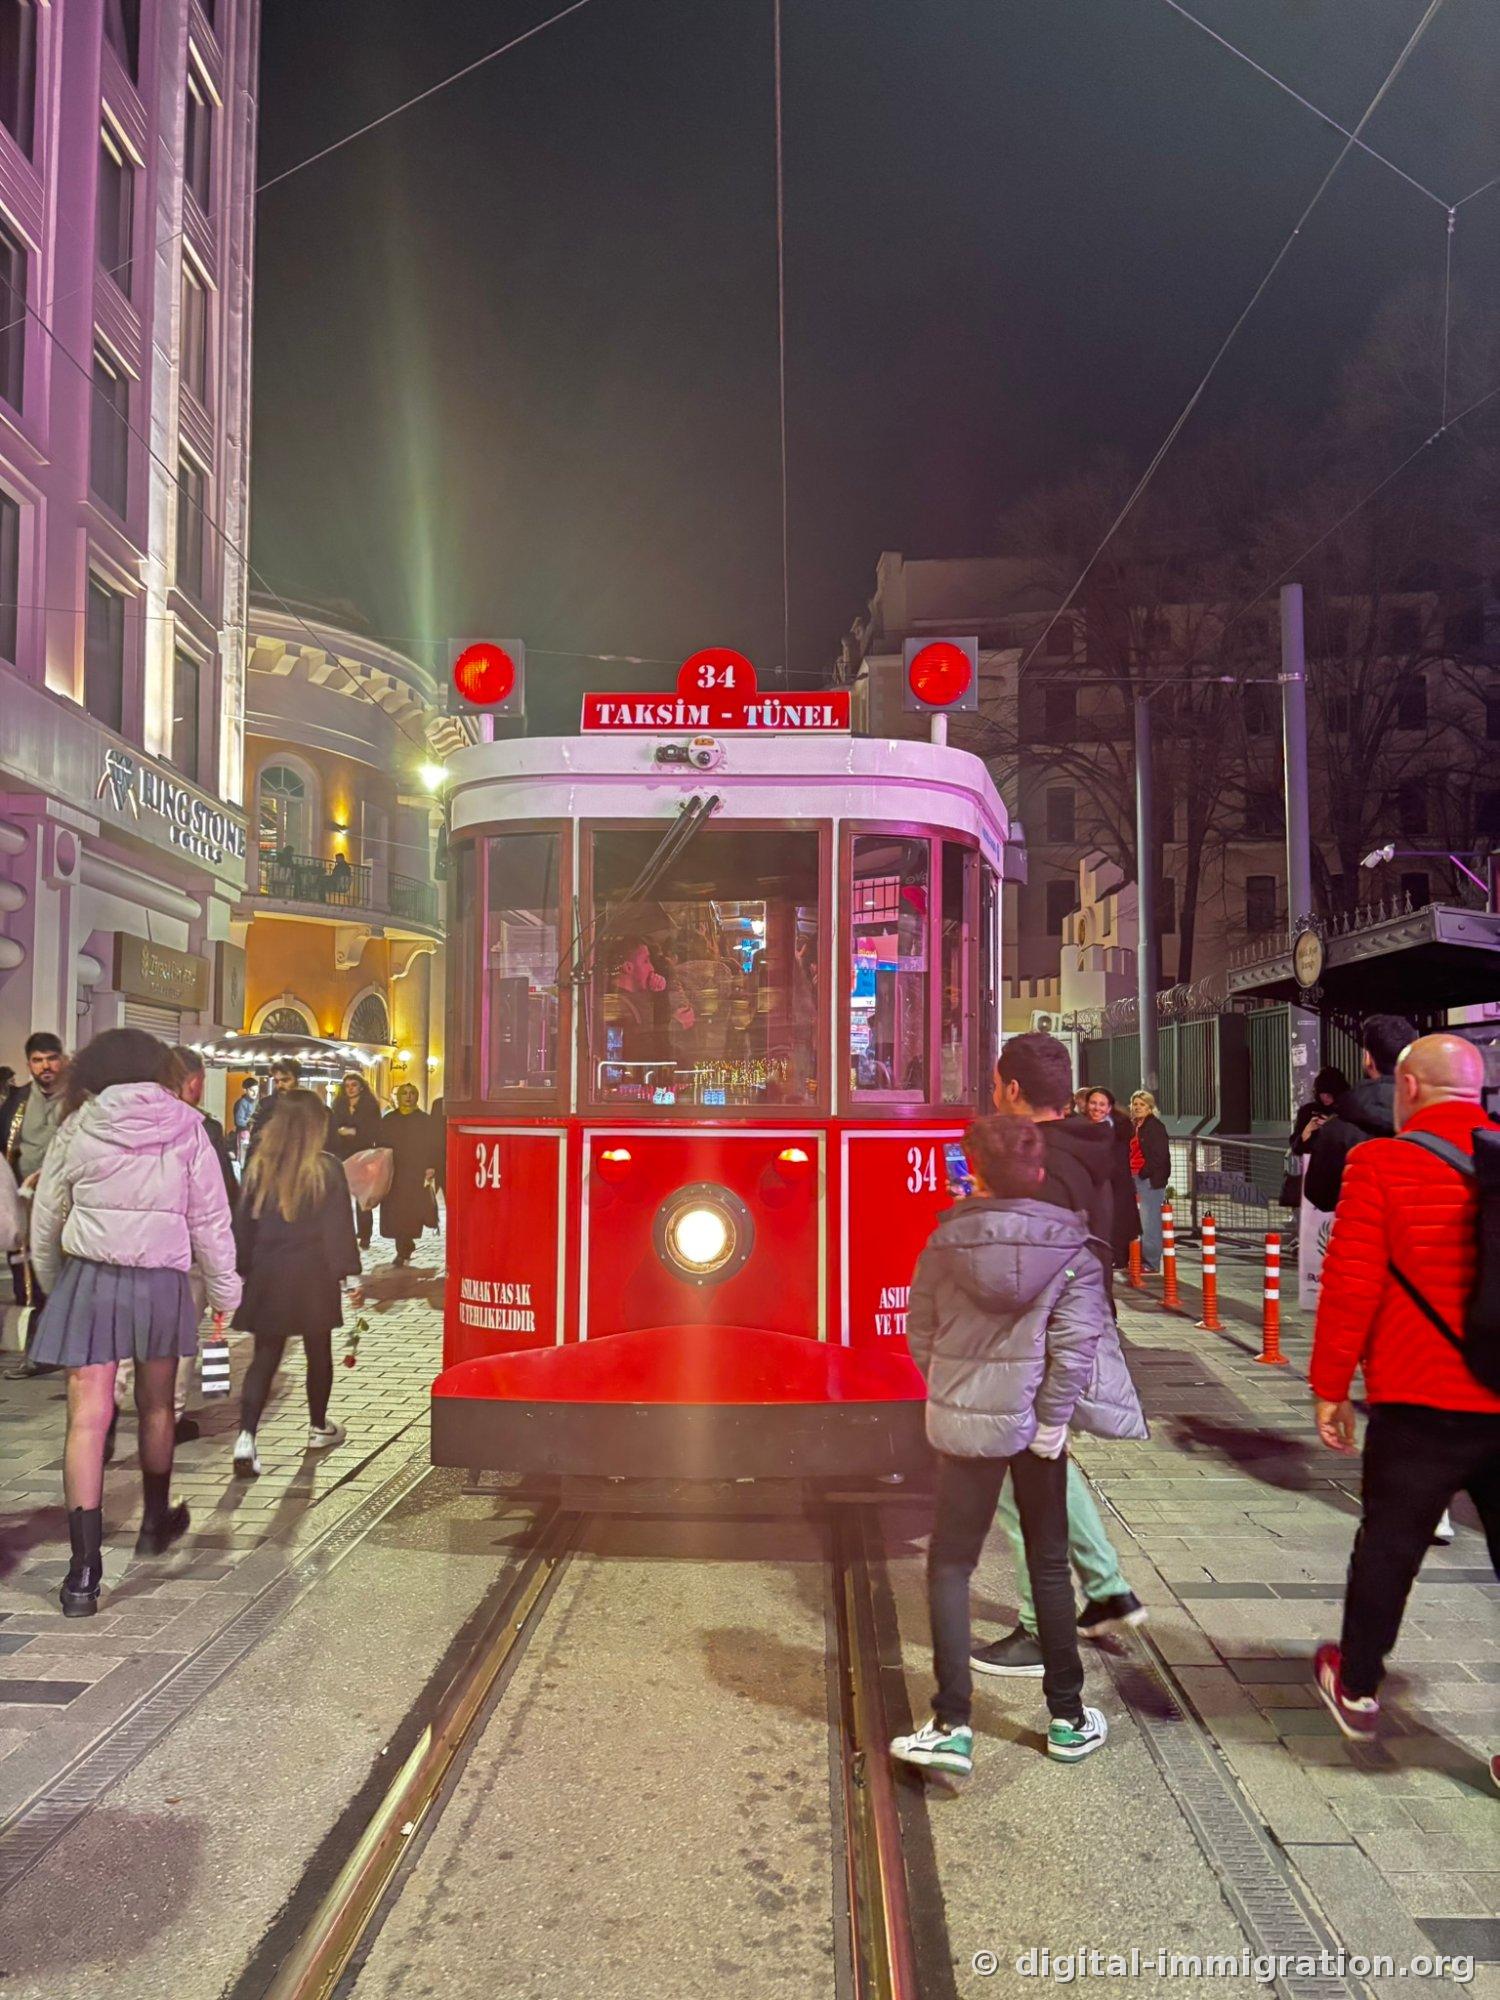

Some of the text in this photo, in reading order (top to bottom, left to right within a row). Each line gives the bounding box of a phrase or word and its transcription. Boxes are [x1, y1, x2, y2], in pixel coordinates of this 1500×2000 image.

[697, 665, 736, 688] 34
[596, 699, 710, 725] TAKSİM
[743, 699, 839, 727] TÜNEL
[475, 1142, 501, 1189] 34
[907, 1146, 937, 1193] 34
[493, 1282, 531, 1306] YASAK
[875, 1313, 891, 1335] VE
